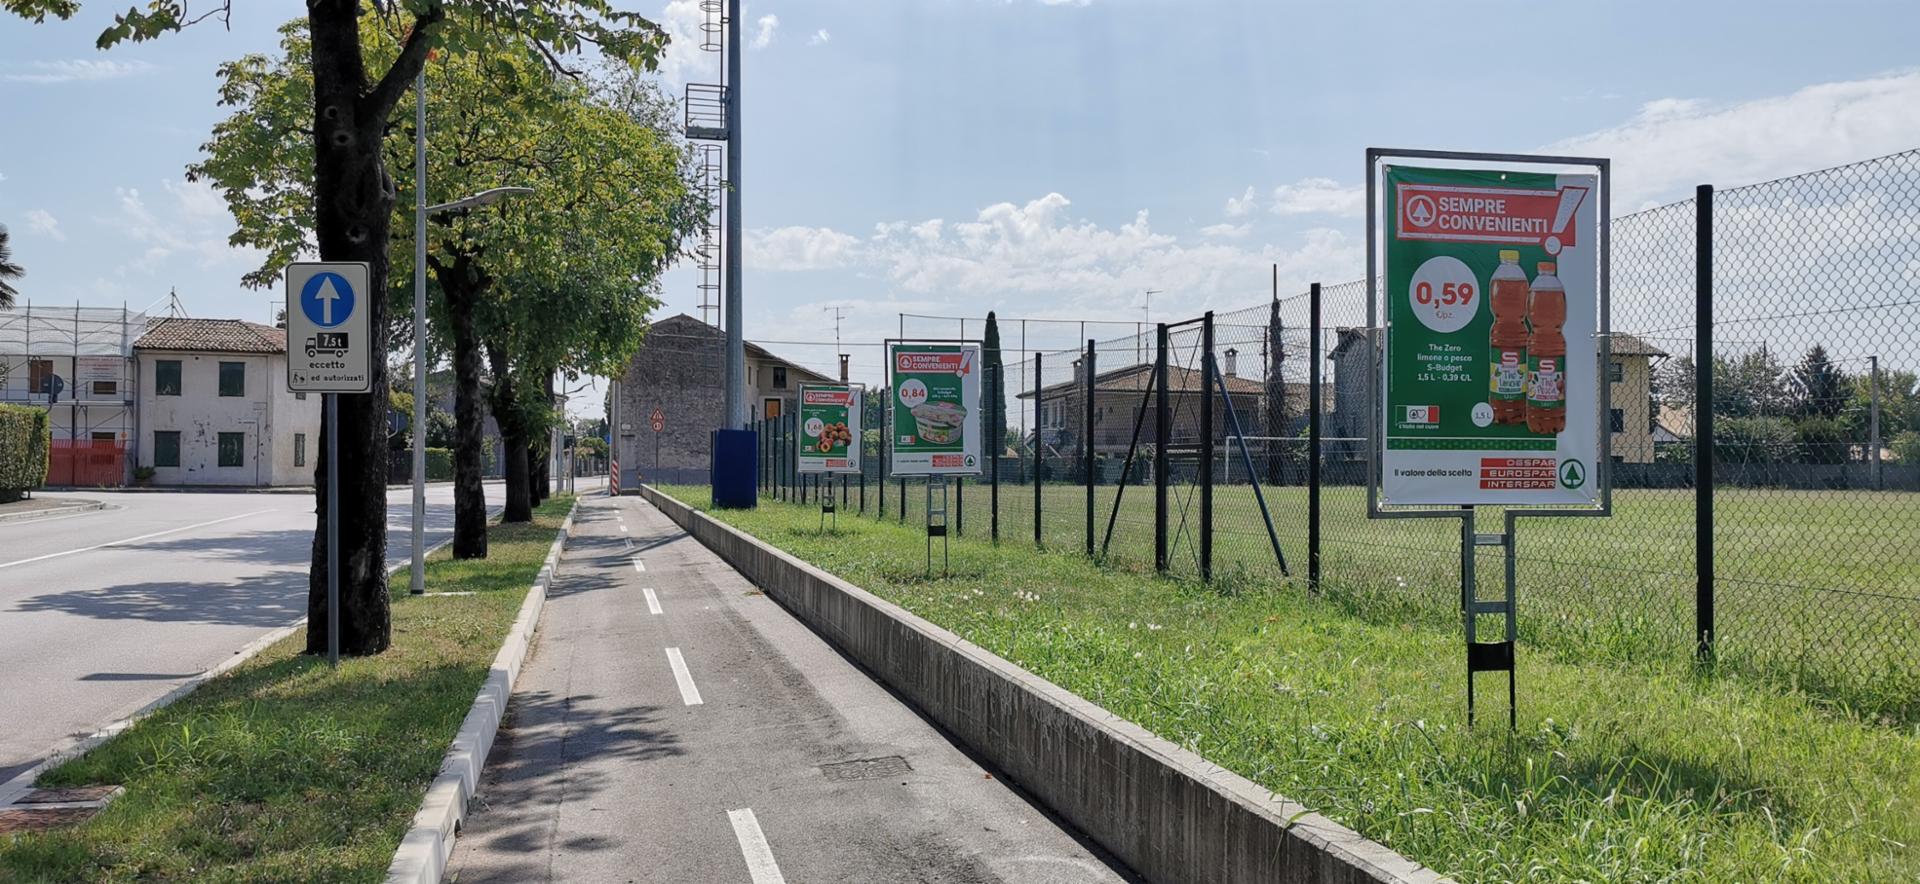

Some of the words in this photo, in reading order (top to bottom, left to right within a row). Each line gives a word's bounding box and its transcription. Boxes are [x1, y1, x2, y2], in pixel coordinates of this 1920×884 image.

[1439, 197, 1506, 214] SEMPRE
[1438, 215, 1548, 233] CONVENIENTI
[1416, 282, 1474, 309] 0,59
[1428, 343, 1443, 351] The
[1444, 344, 1461, 352] Zero
[912, 355, 940, 363] SEMPRE
[1417, 353, 1442, 361] limone
[309, 361, 345, 369] eccetto
[1427, 363, 1462, 373] S-Budget
[901, 388, 925, 399] 0,84
[1506, 459, 1556, 467] DESPAR
[1400, 469, 1426, 477] valore
[1426, 469, 1447, 477] della
[1448, 469, 1473, 477] scelta
[1489, 469, 1557, 477] EUROSPAR
[1488, 480, 1556, 488] INTERSPAR
